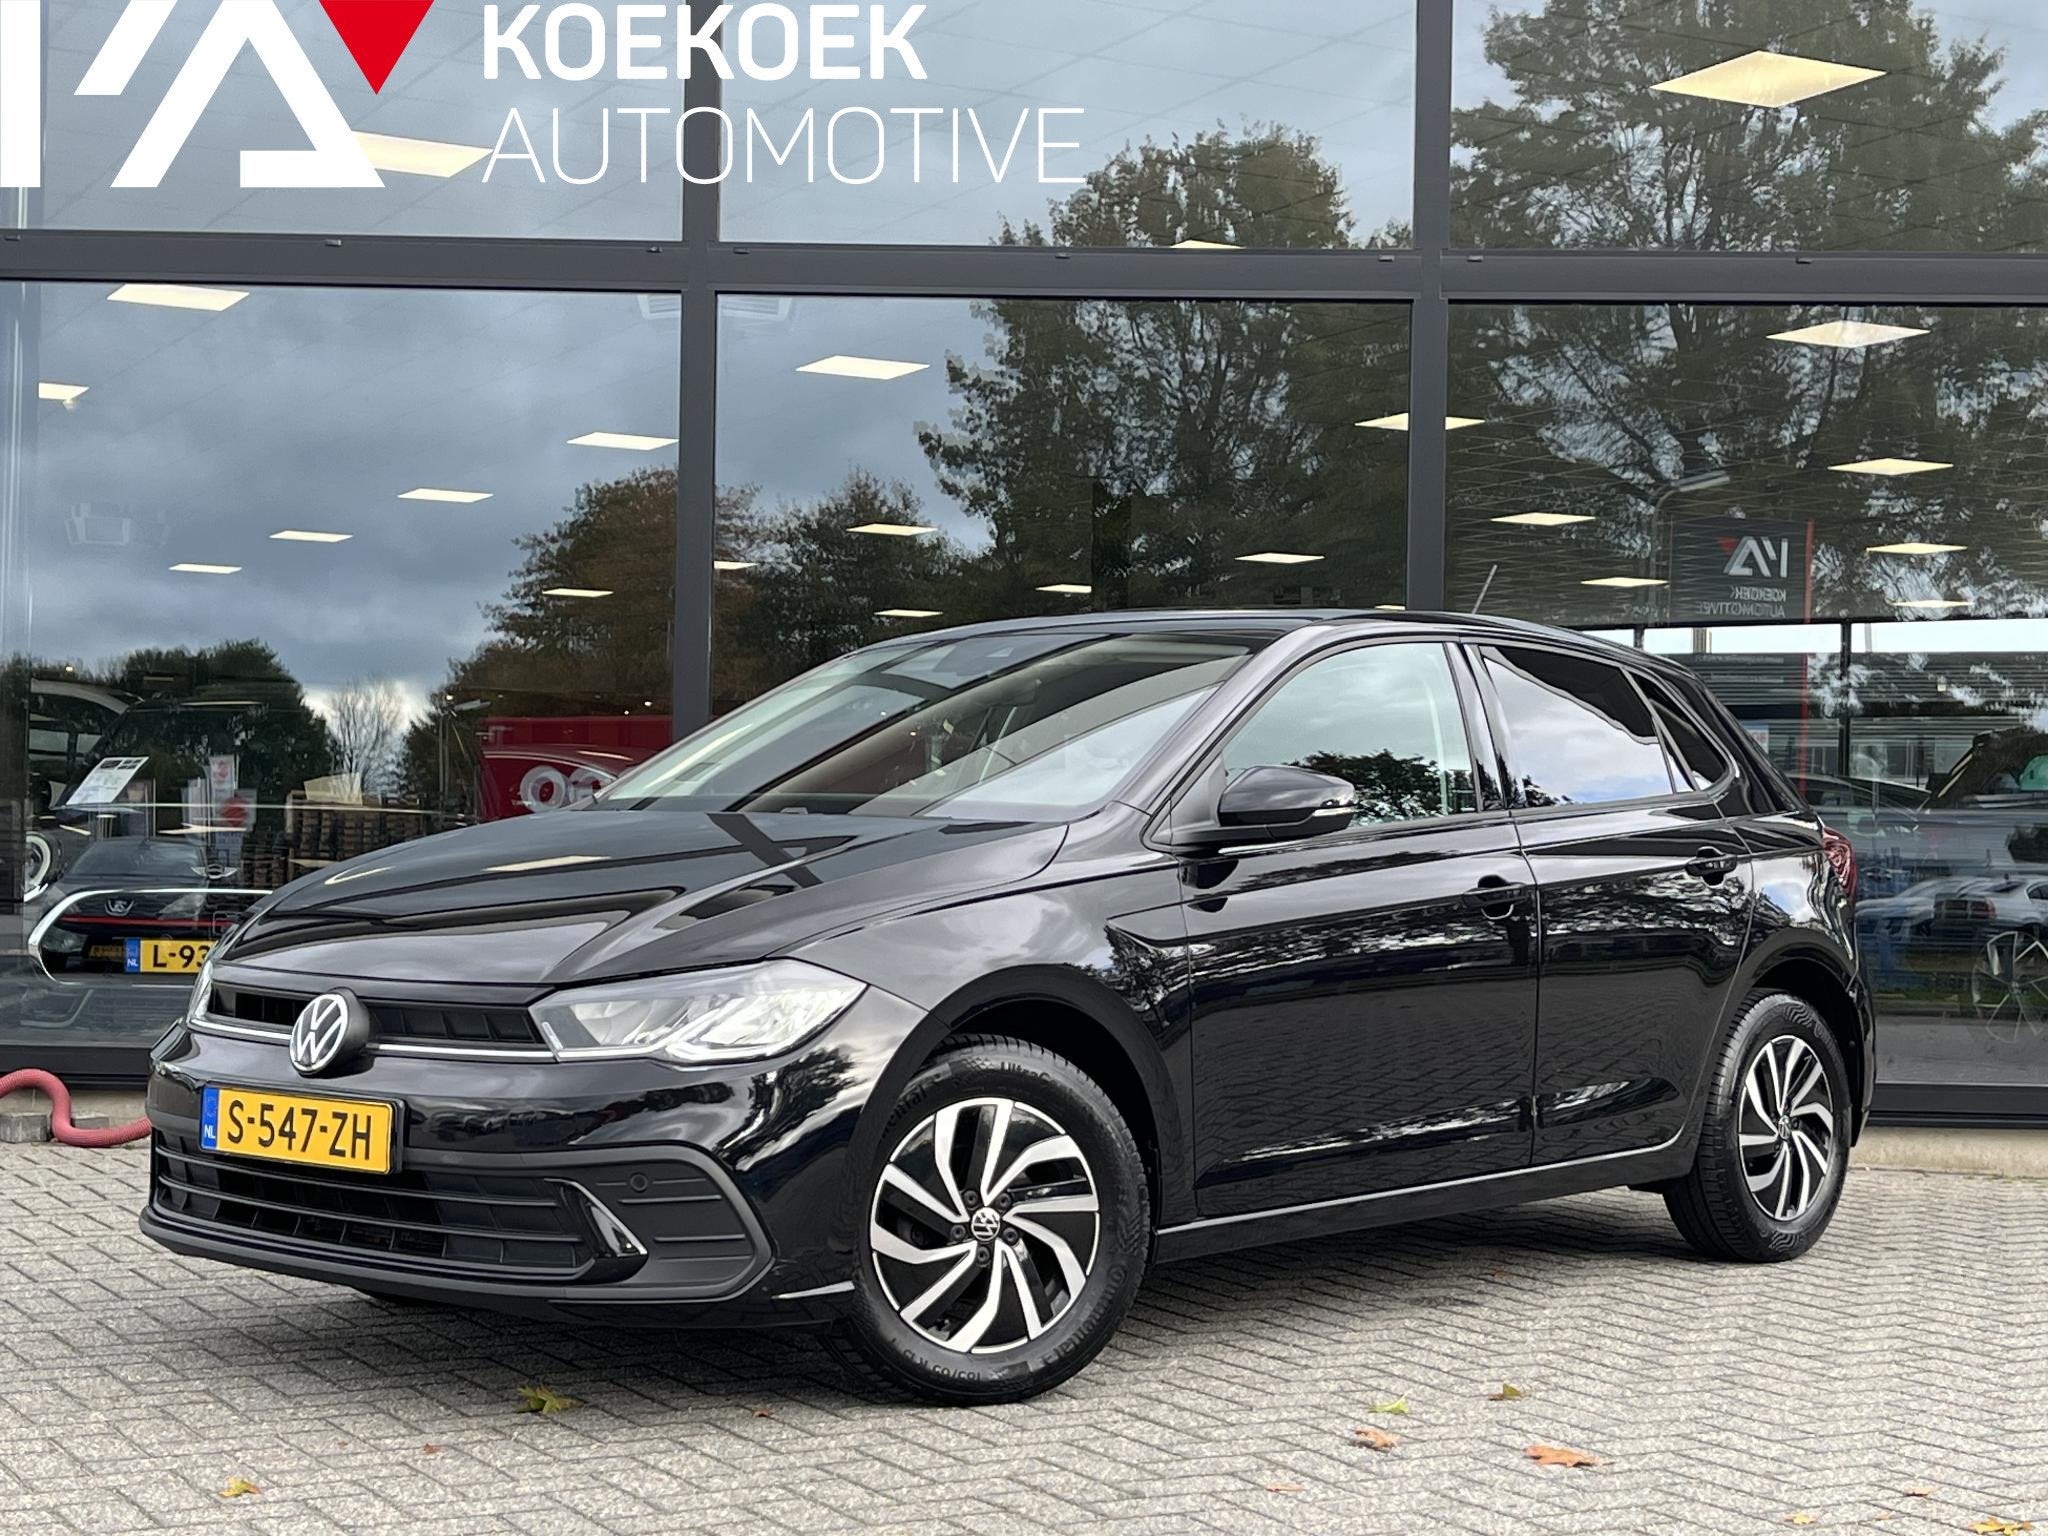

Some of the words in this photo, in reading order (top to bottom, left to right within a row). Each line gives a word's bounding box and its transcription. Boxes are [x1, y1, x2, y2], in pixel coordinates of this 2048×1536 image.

[126, 958, 139, 967] NL
[203, 1123, 217, 1140] NL
[227, 1099, 372, 1161] S-547-ZH
